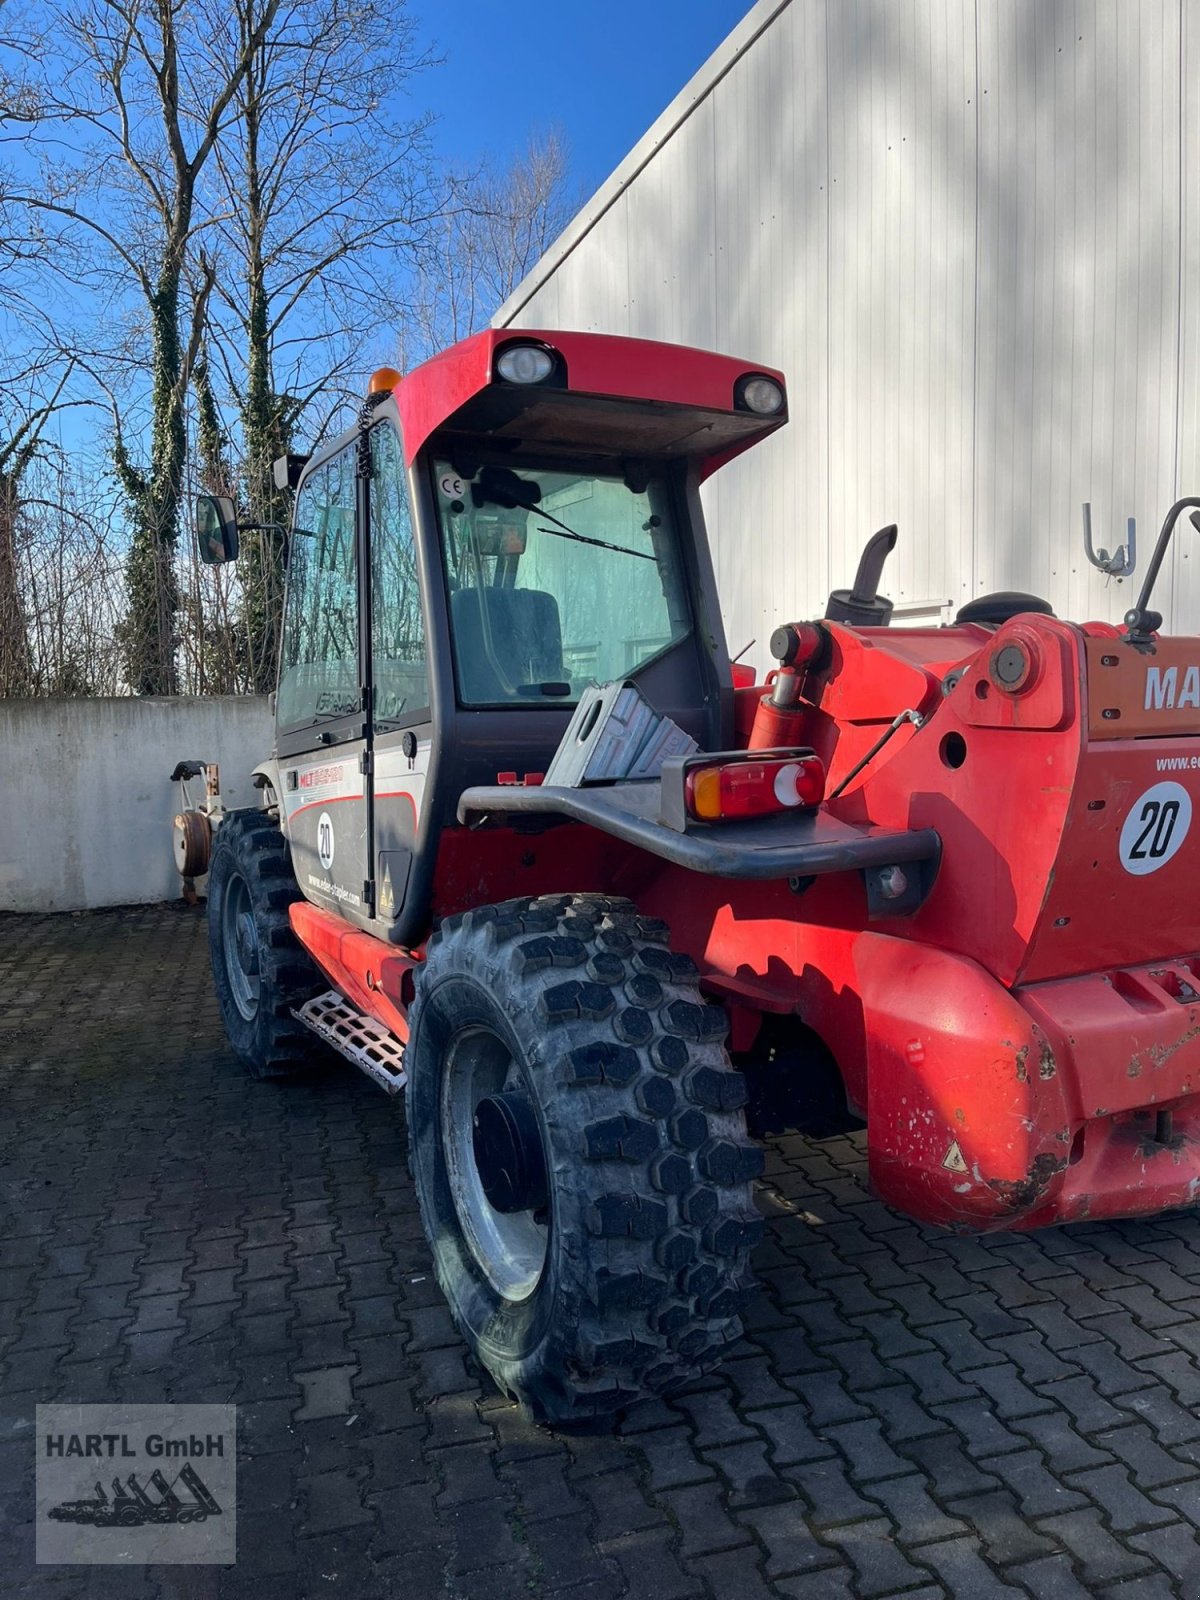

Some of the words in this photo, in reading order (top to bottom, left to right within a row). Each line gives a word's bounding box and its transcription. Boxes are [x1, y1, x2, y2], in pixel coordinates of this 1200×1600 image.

[441, 478, 462, 495] CE
[1144, 666, 1200, 710] MA
[320, 823, 331, 859] 20
[1128, 800, 1180, 860] 20
